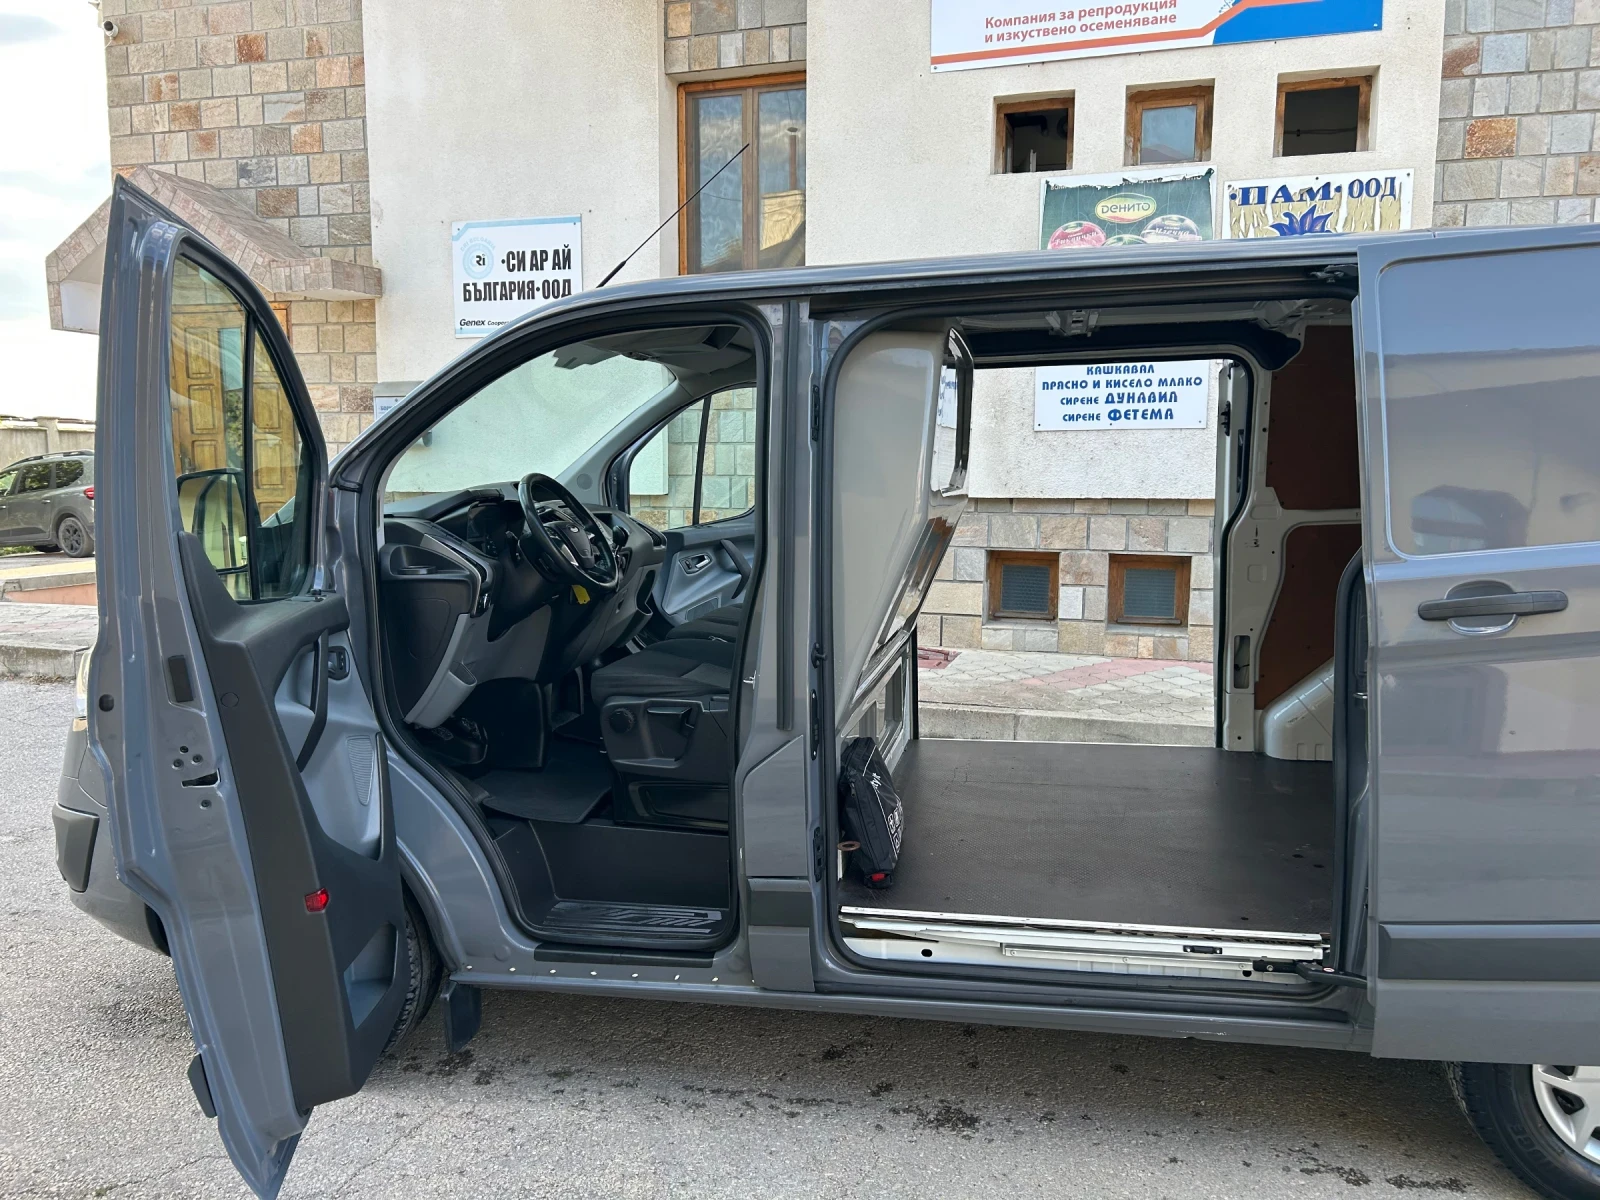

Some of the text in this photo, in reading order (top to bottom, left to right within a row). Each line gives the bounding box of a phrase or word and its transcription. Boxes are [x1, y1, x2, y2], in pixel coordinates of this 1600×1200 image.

[985, 0, 1177, 29] Компания за репродукция
[984, 13, 1177, 43] и изкуствено осеменяване
[1348, 176, 1397, 202] ООД
[529, 249, 549, 271] АР
[551, 244, 572, 270] АЙ
[459, 318, 486, 326] Genex
[1086, 364, 1155, 376] КАШКАВАЛ
[1042, 379, 1088, 391] ПРЯСНО
[1092, 379, 1101, 389] И
[1105, 378, 1153, 389] КИСЕЛО
[1060, 396, 1100, 406] СИРЕНЕ
[1062, 408, 1174, 422] СИРЕНЕ ФЕТЕМА
